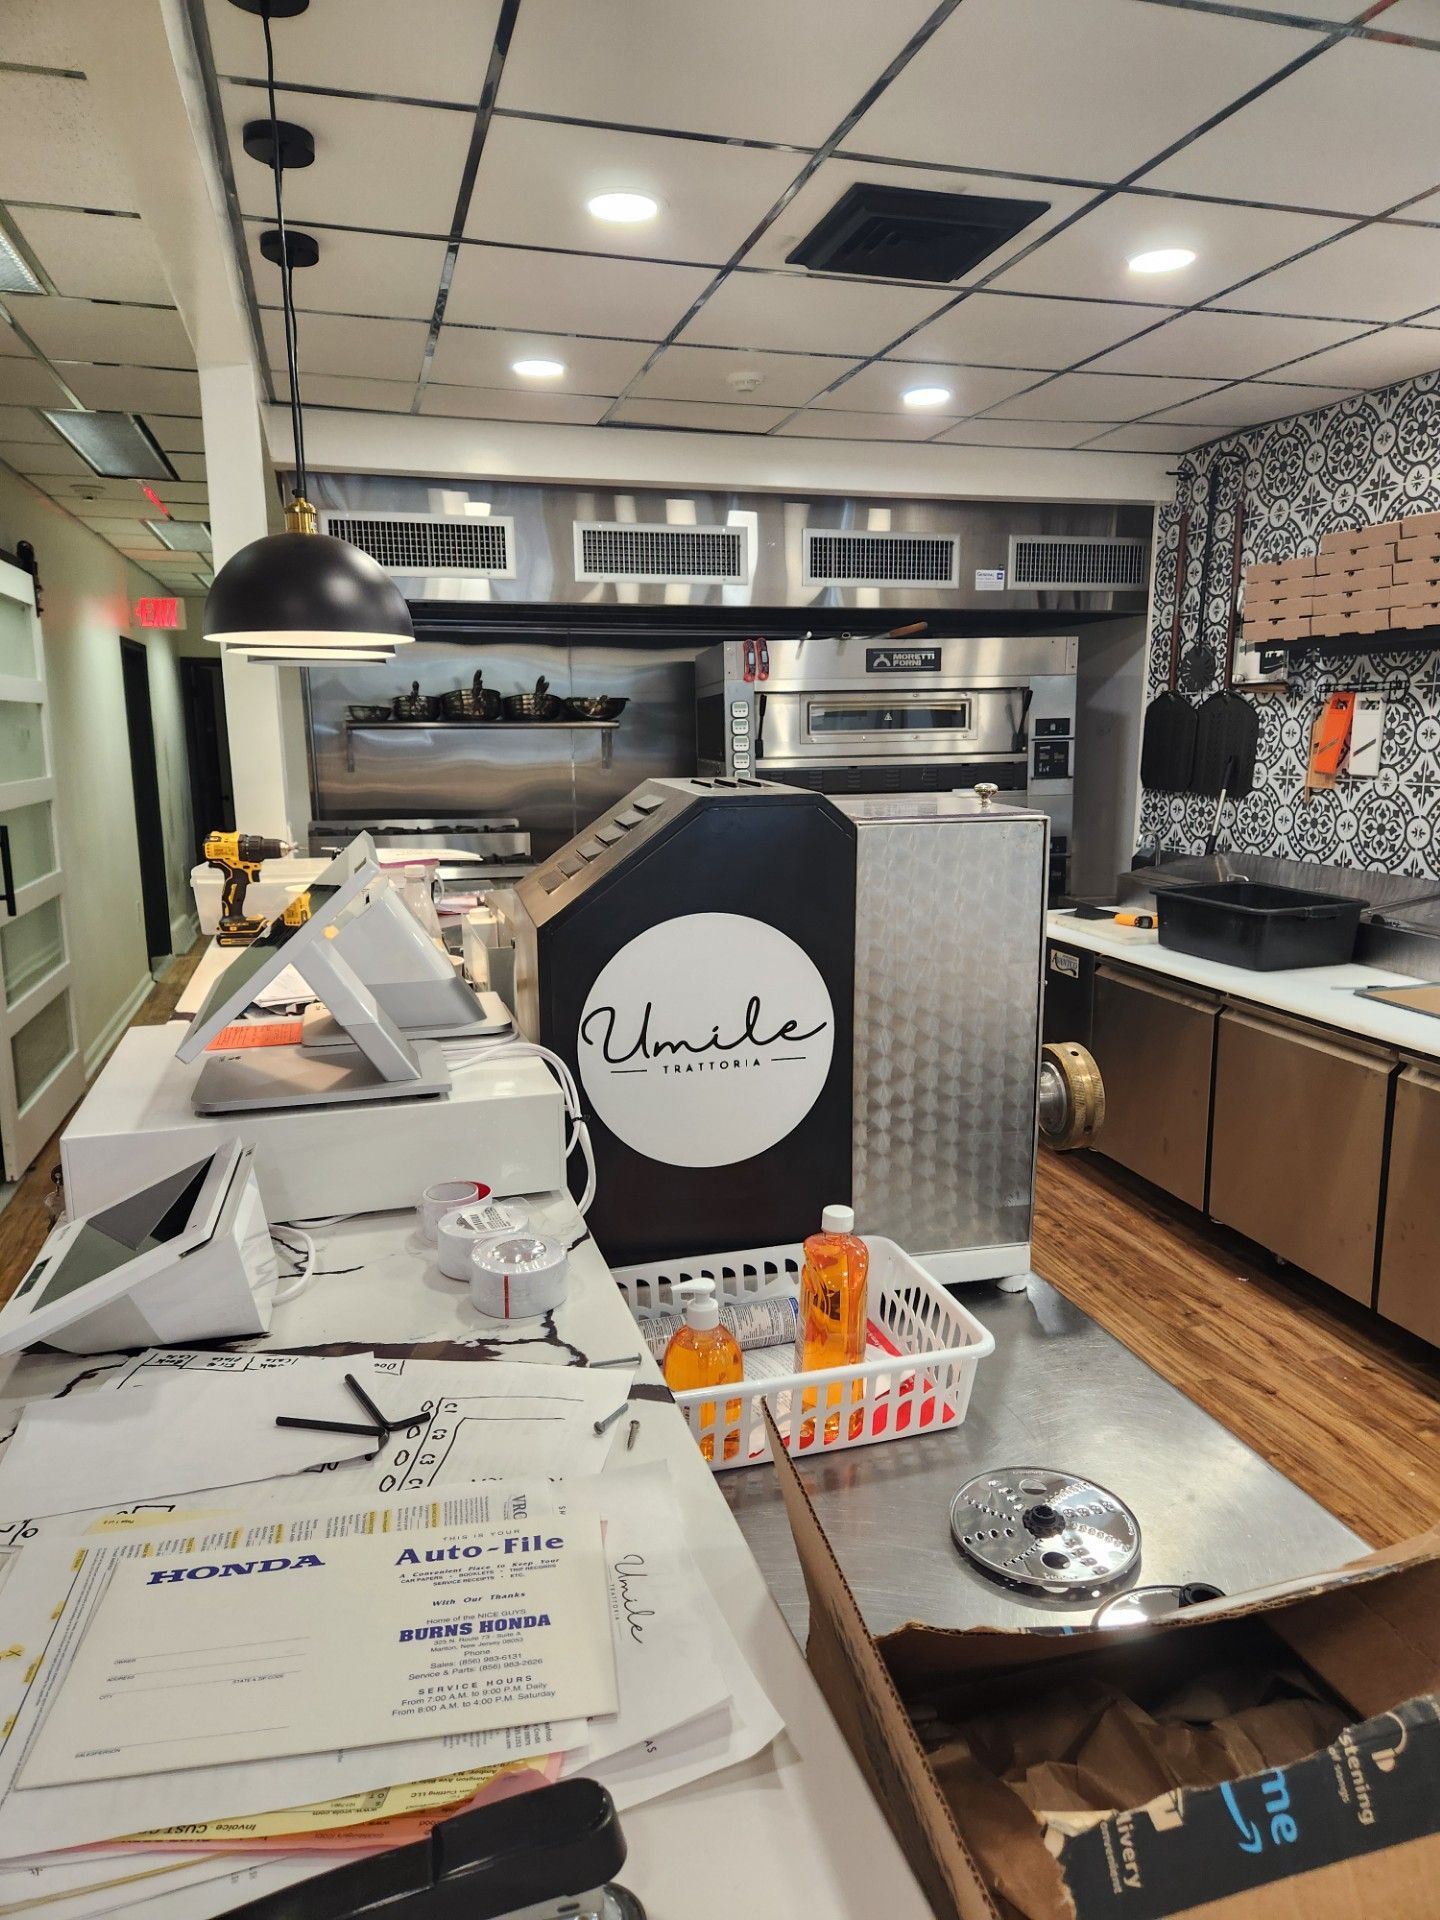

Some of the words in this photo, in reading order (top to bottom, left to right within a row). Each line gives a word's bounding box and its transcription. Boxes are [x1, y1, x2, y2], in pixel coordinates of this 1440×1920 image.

[581, 996, 828, 1064] Umile
[662, 1059, 761, 1075] TRATTORIA
[443, 1534, 468, 1542] THIS
[490, 1528, 520, 1537] YOUR
[394, 1534, 564, 1567] Auto-File
[146, 1554, 326, 1586] HONDA
[412, 1566, 463, 1578] Convenient
[468, 1564, 491, 1572] Place
[512, 1560, 534, 1569] Keep
[540, 1557, 560, 1565] Your
[458, 1569, 495, 1578] BOOKLETS
[432, 1579, 462, 1587] SERVICE
[462, 1575, 495, 1584] RECEIPTS
[432, 1599, 456, 1607] With
[463, 1595, 482, 1604] Our
[490, 1591, 526, 1601] Thanks
[609, 1583, 620, 1622] TRATTORIA
[614, 1553, 655, 1645] Umile
[426, 1616, 450, 1625] Home
[463, 1613, 476, 1621] the
[477, 1611, 498, 1619] NICE
[501, 1608, 527, 1617] GUYS
[398, 1621, 473, 1643] BURNS
[479, 1614, 551, 1634] HONDA
[460, 1642, 476, 1650] New
[478, 1639, 501, 1649] Jersey
[464, 1649, 491, 1657] Phone
[408, 1671, 441, 1681] Service
[442, 1669, 450, 1677] &
[452, 1666, 476, 1676] Parts:
[479, 1663, 502, 1672] (856)
[503, 1658, 543, 1669] 983-2626
[430, 1661, 457, 1670] Sales:
[459, 1658, 481, 1667] (856)
[483, 1652, 523, 1663] 983-6131
[401, 1698, 426, 1707] From
[427, 1694, 447, 1704] 7:00
[470, 1690, 480, 1698] to
[482, 1688, 501, 1697] 9:00
[525, 1682, 548, 1692] Daily
[417, 1682, 479, 1696] SERVICE
[486, 1675, 533, 1687] HOURS
[392, 1707, 415, 1717] From
[417, 1705, 437, 1714] 8:00
[462, 1700, 472, 1708] to
[473, 1697, 493, 1708] 4:00
[517, 1690, 557, 1702] Saturday
[1338, 1727, 1376, 1826] stening
[216, 1822, 257, 1833] Invoice
